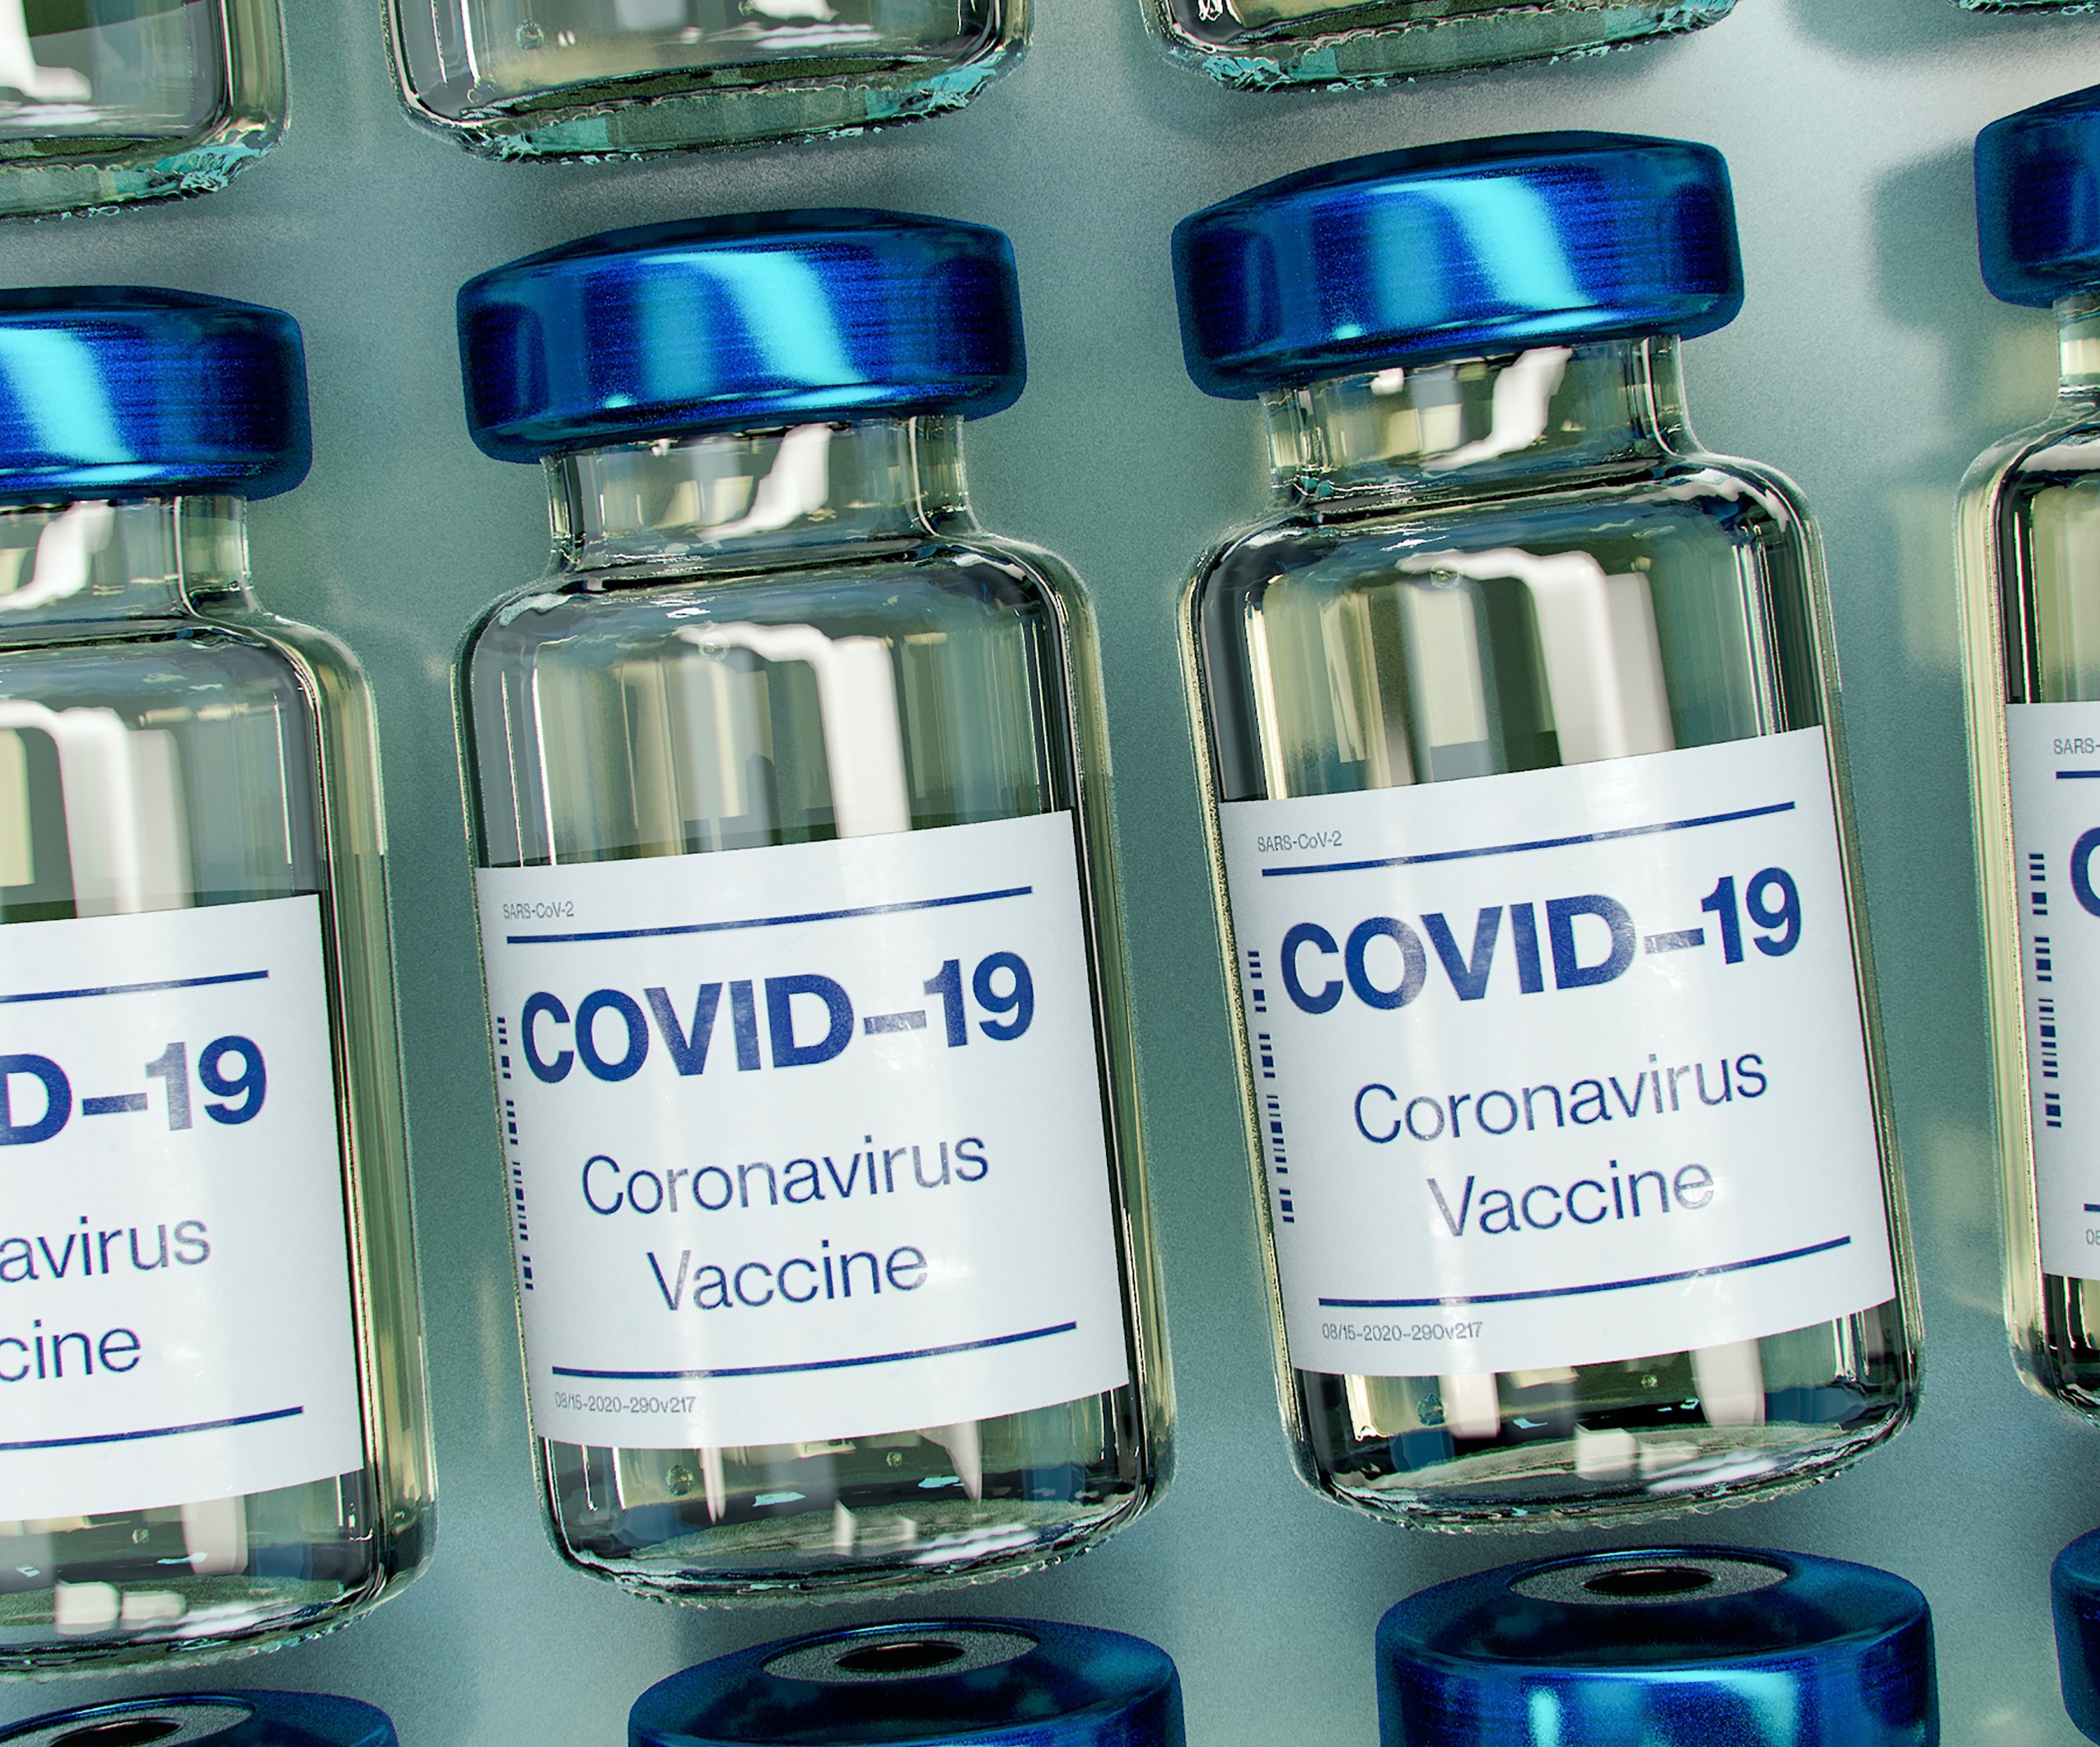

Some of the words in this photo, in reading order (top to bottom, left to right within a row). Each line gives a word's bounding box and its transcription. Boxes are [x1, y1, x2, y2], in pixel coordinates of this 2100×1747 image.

[1257, 829, 1342, 853] SARS-CoV-2
[503, 901, 574, 919] SARS-CoV-2
[1279, 866, 1802, 1015] COVID-19
[521, 951, 1035, 1084] COVID-19
[1354, 1053, 1769, 1145] Coronavirus
[581, 1134, 989, 1216] Coronavirus
[1426, 1159, 1714, 1237] Vaccine
[646, 1239, 929, 1311] Vaccine
